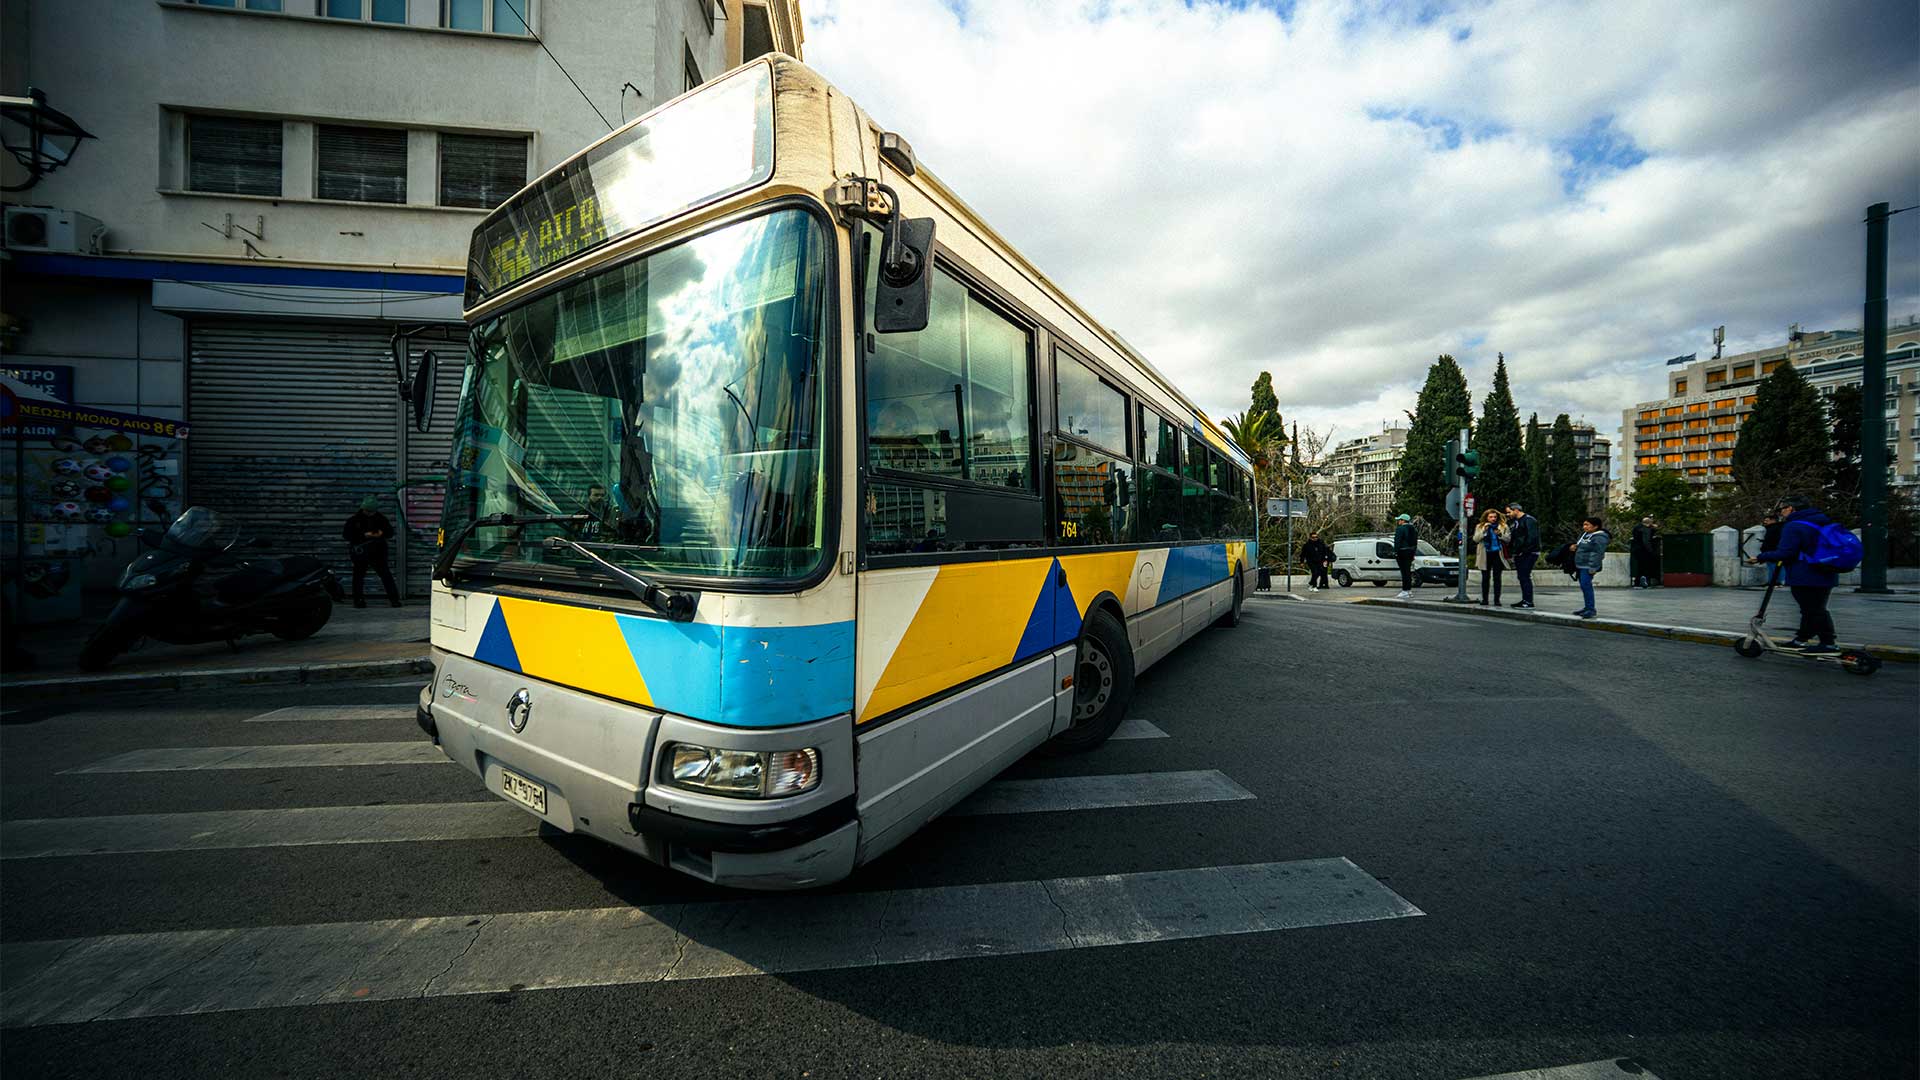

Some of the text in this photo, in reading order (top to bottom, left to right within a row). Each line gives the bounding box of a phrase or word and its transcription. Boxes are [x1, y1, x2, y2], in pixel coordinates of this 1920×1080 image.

[75, 411, 119, 427] ΜΟΝΟ
[123, 420, 151, 431] ΑΠΟ
[1061, 521, 1077, 538] 764
